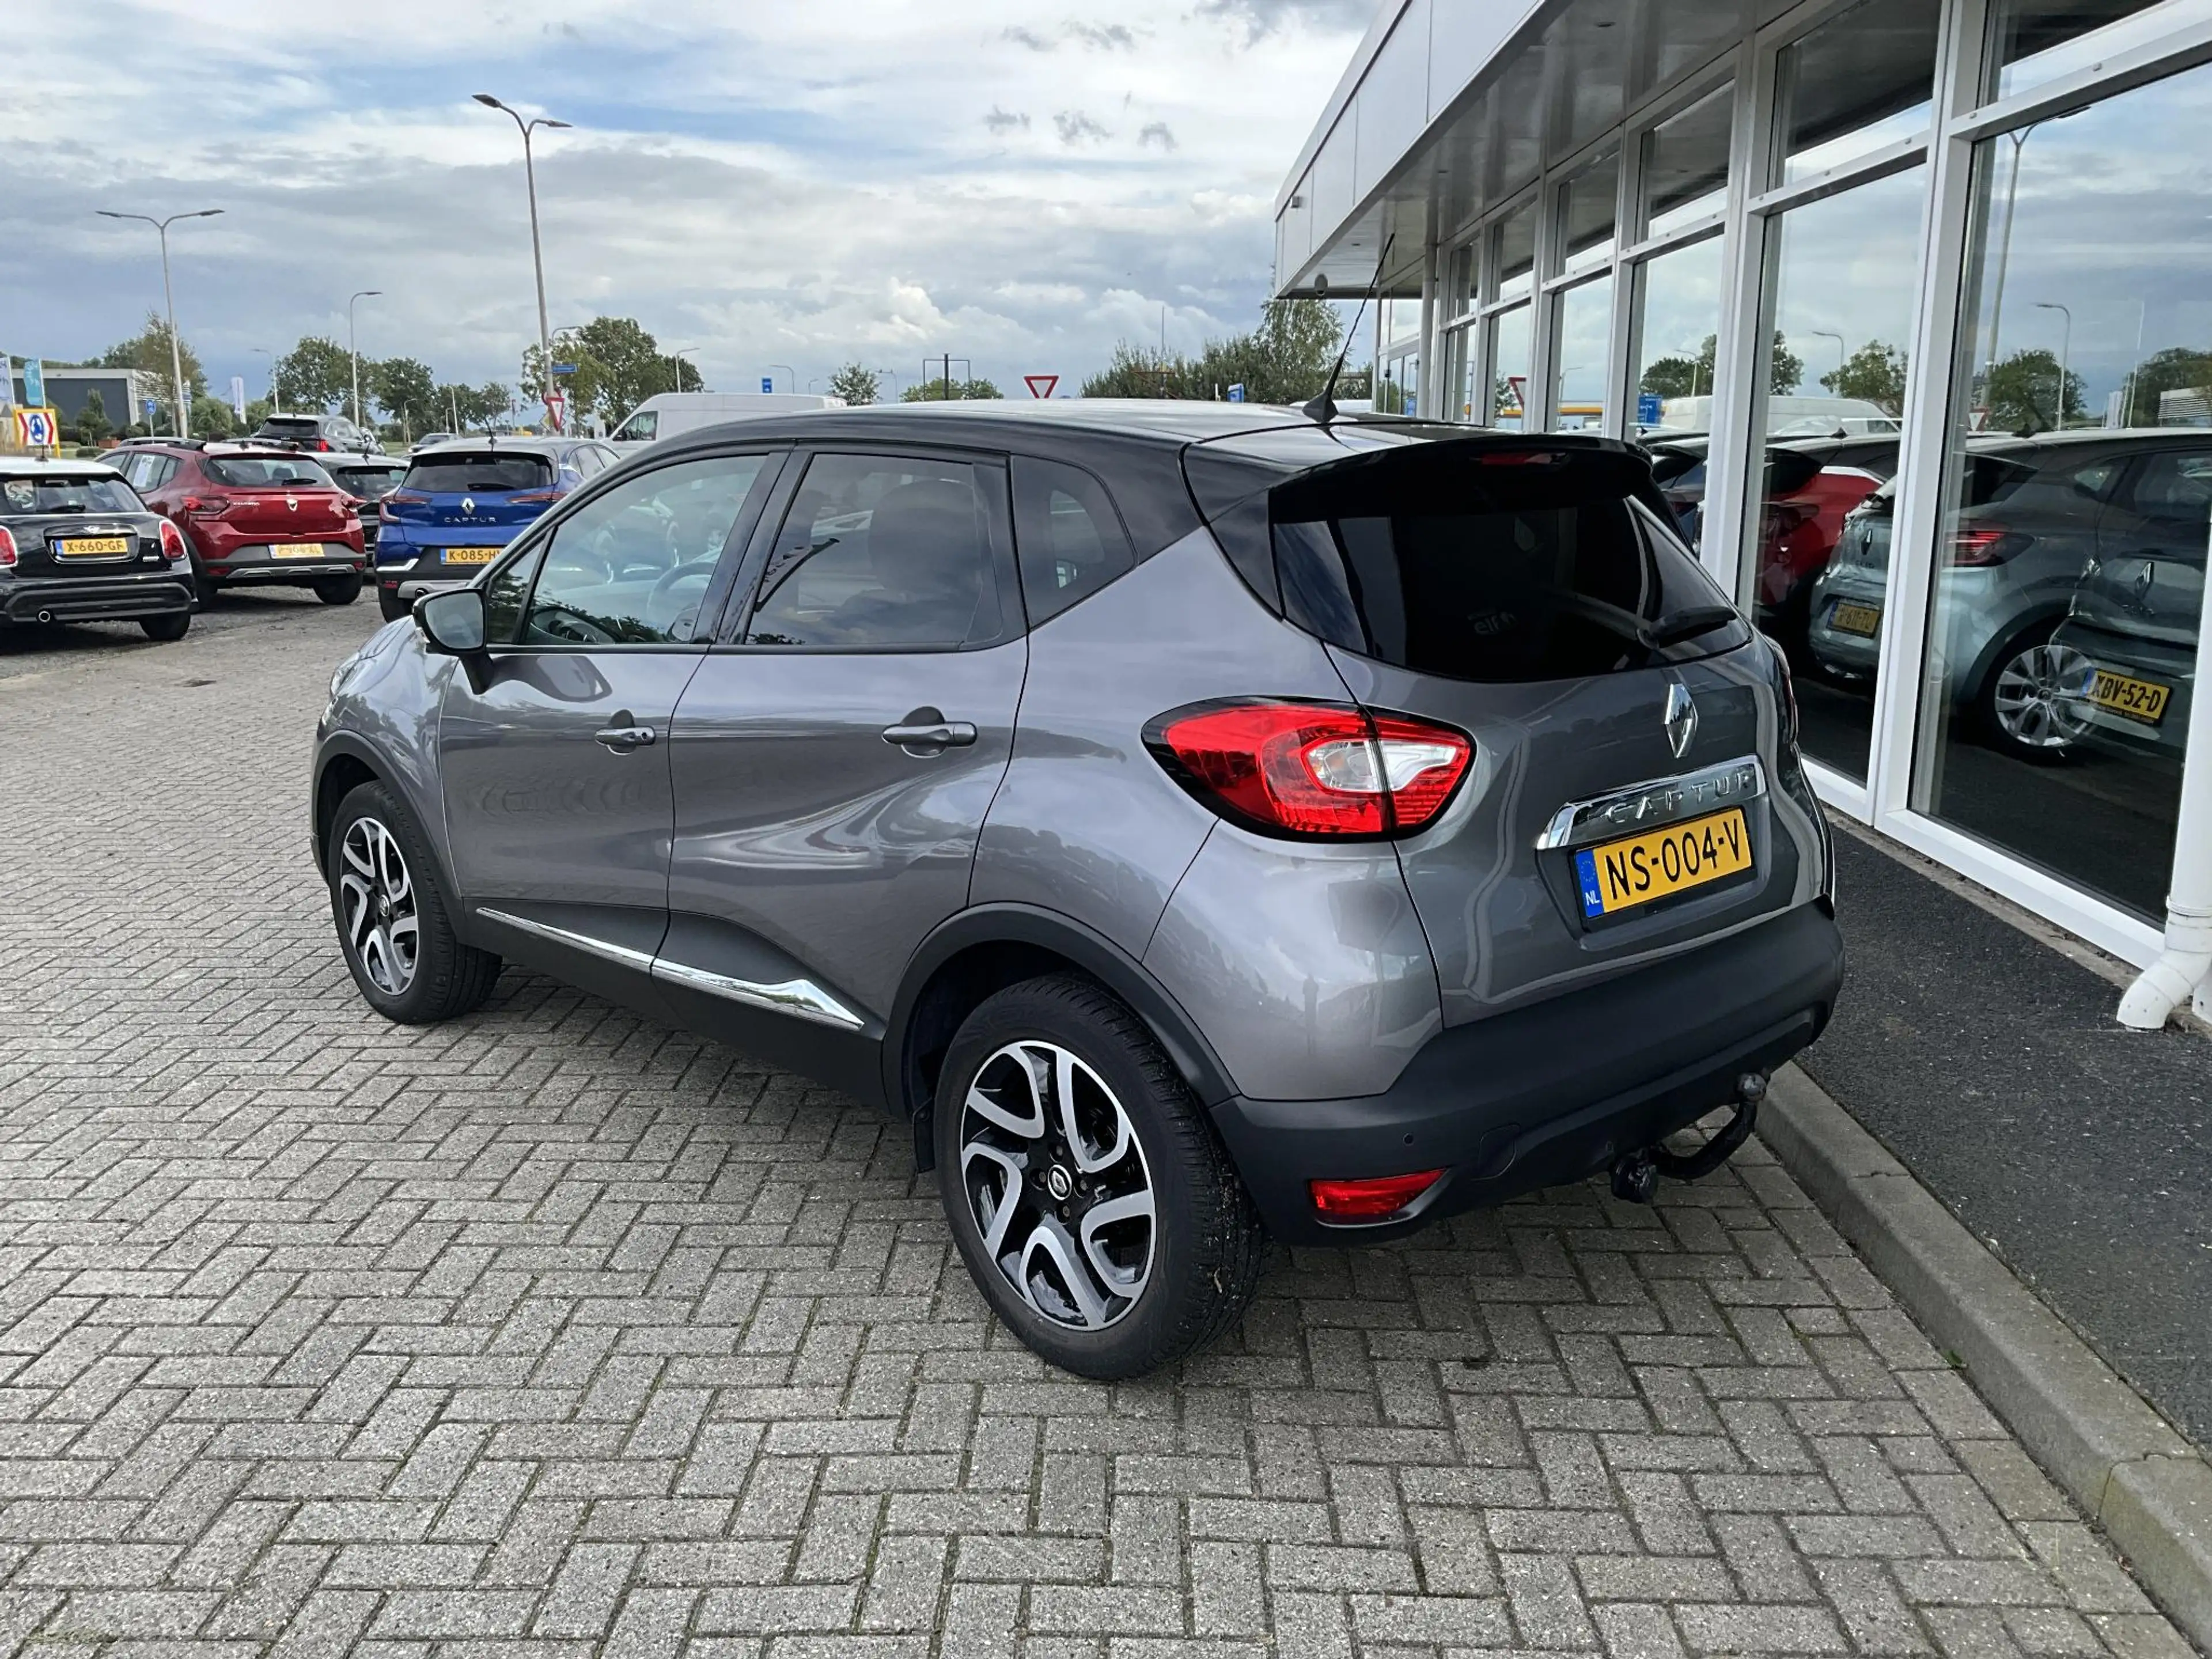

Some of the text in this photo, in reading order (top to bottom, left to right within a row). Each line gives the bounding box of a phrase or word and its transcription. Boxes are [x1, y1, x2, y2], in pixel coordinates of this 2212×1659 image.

[2092, 675, 2161, 713] XBV-52-D
[1605, 772, 1751, 824] CAPTUR
[1605, 819, 1740, 900] NS-004-V
[1585, 889, 1600, 906] NL
